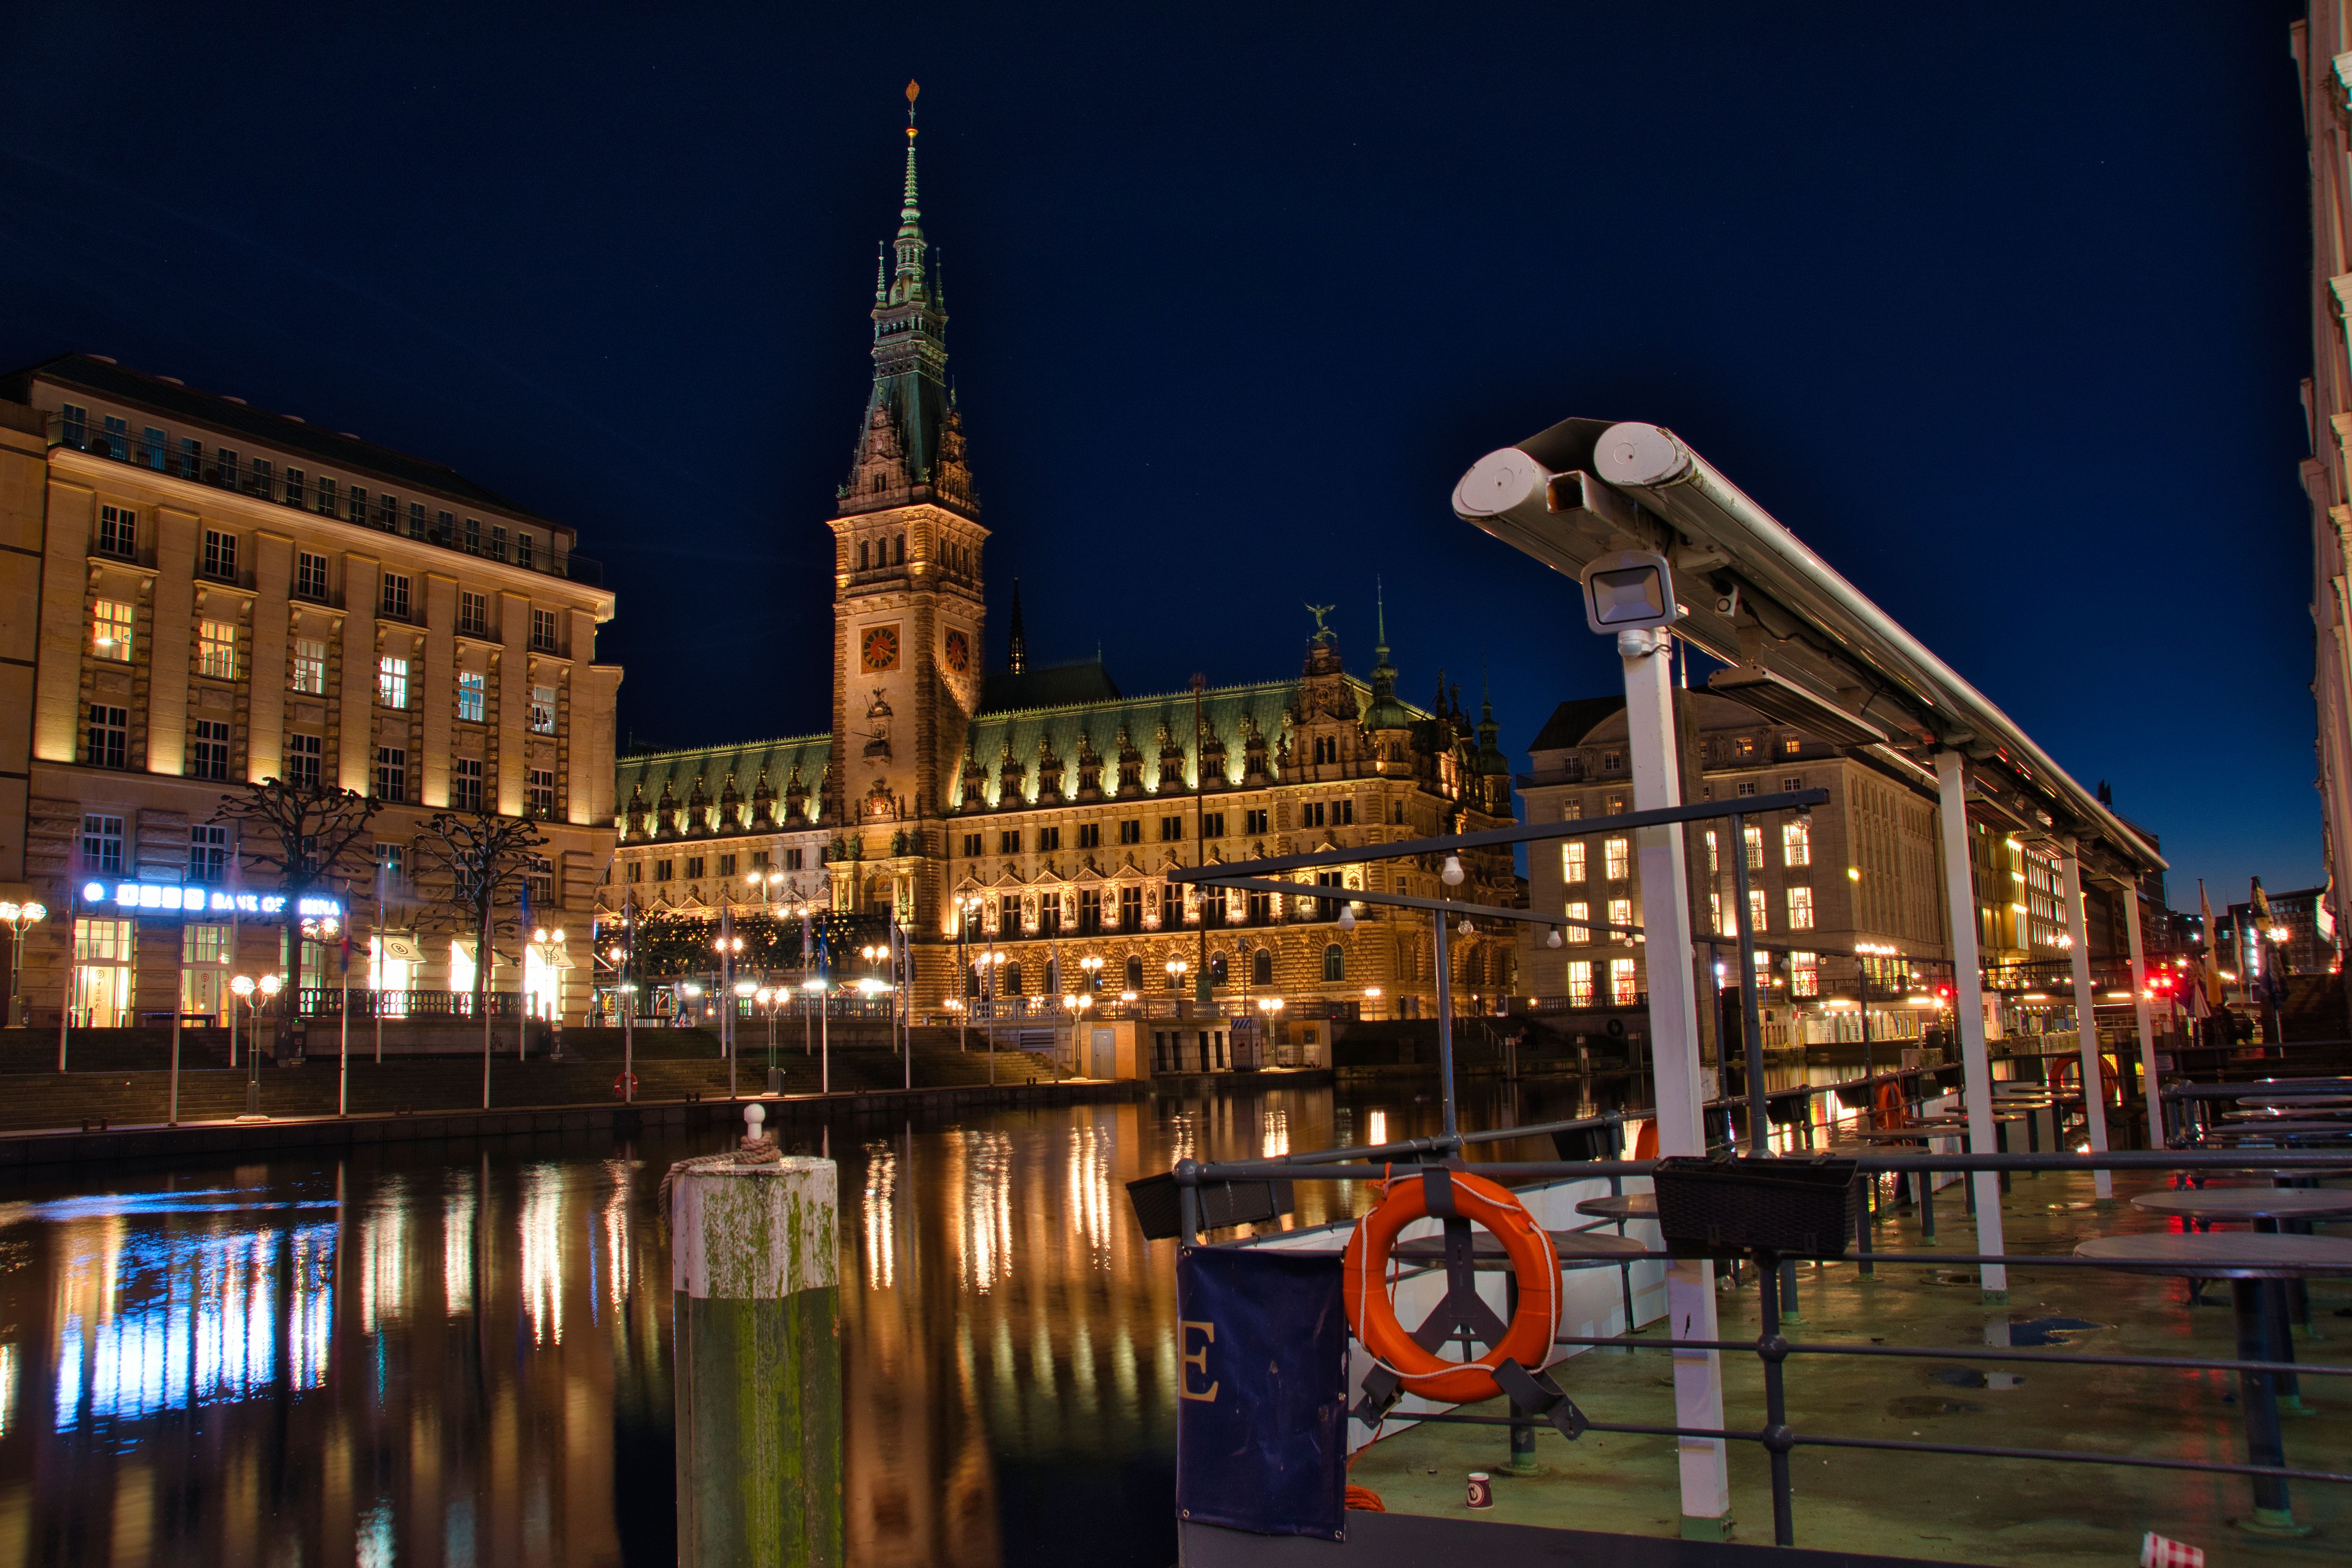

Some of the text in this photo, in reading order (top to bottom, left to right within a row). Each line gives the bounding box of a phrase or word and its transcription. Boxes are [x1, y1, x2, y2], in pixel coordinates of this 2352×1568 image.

[212, 893, 258, 911] BANK
[300, 899, 339, 915] HINA
[1180, 1321, 1218, 1402] E
